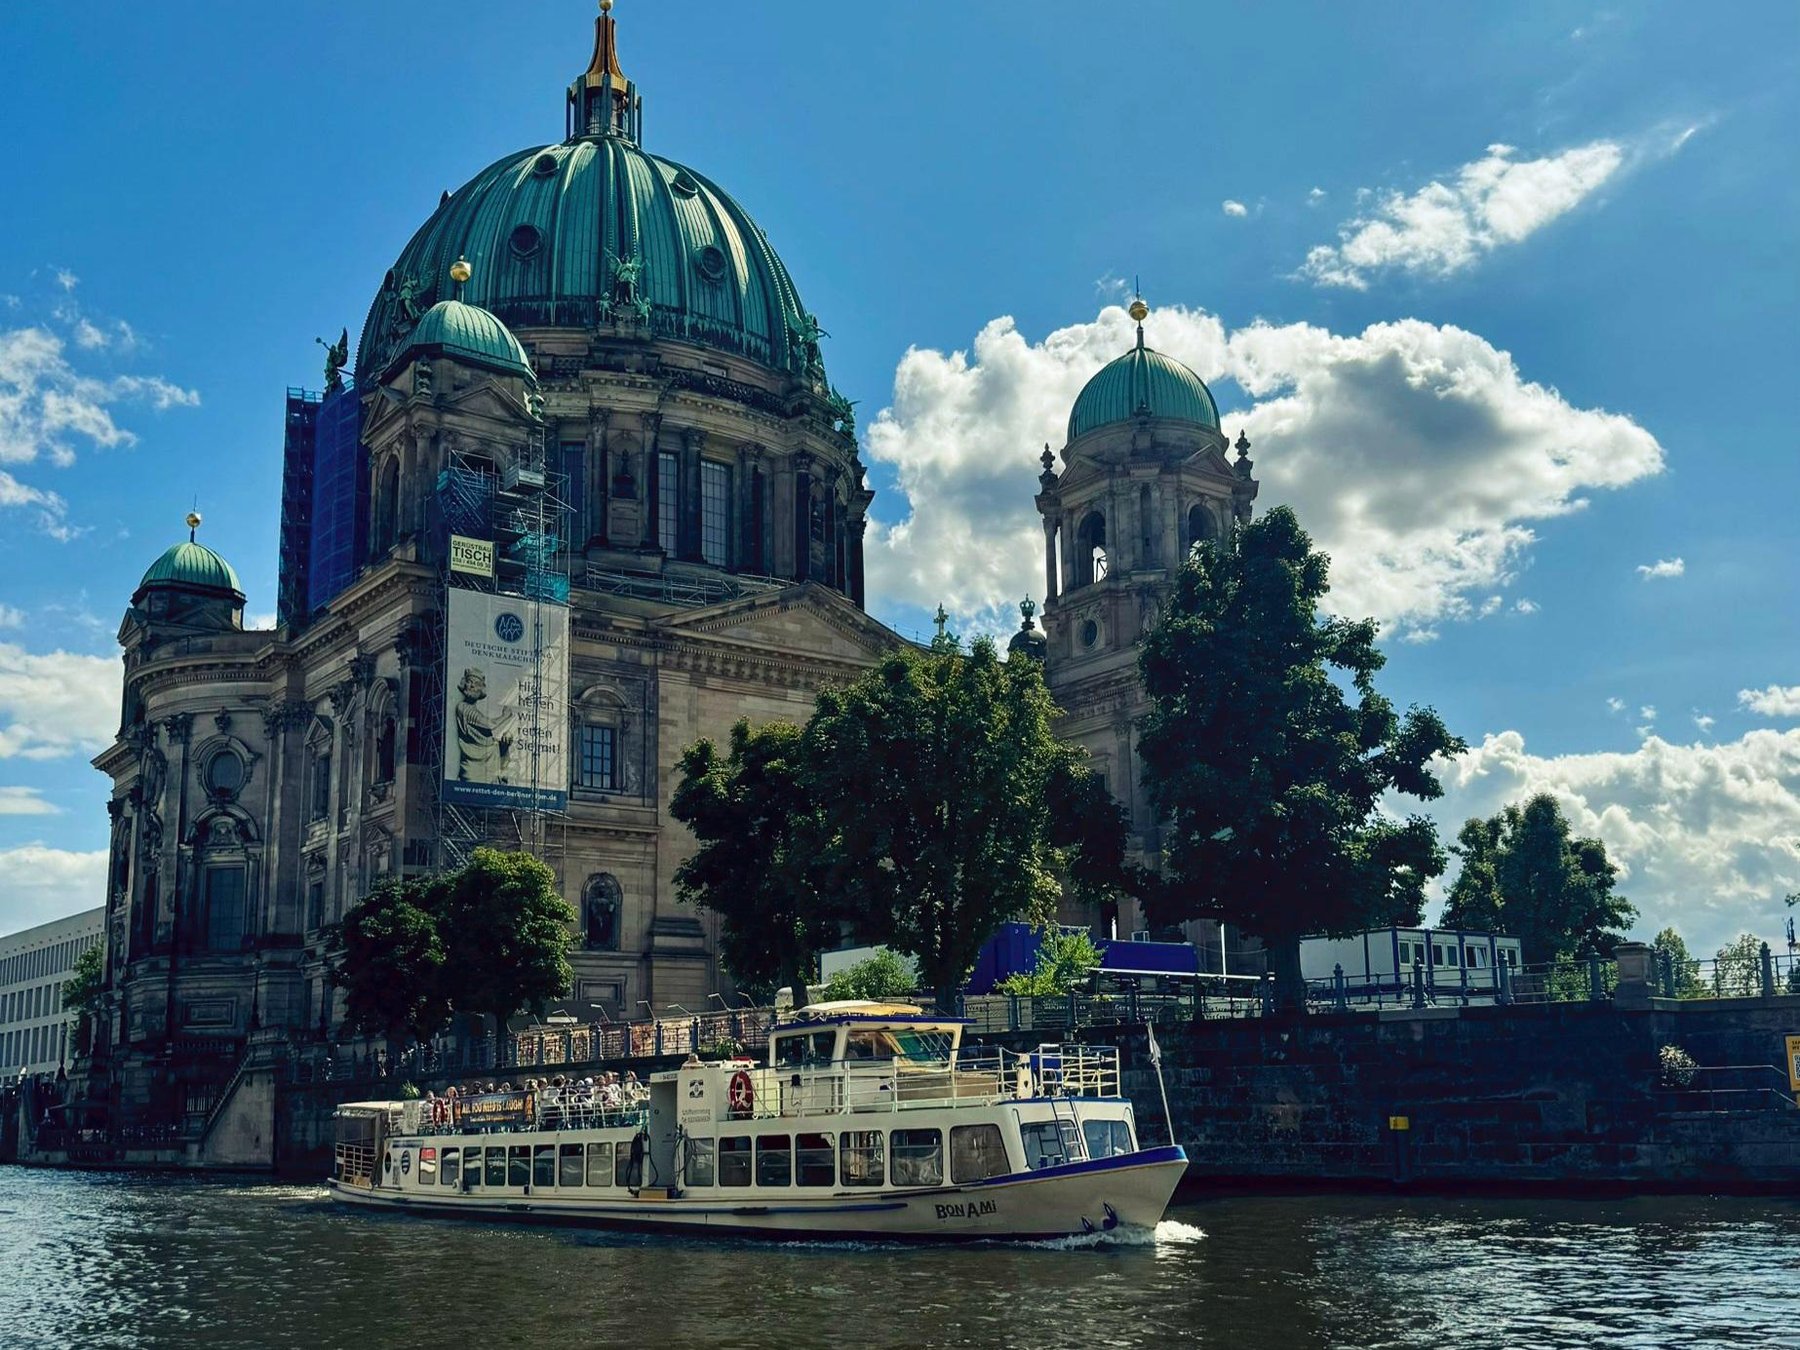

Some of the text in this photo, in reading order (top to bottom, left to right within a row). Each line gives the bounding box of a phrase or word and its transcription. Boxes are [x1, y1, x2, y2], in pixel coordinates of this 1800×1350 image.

[452, 546, 492, 563] TISCH
[464, 640, 552, 659] DEUTSCHE STIFTNG
[518, 694, 554, 711] heen
[516, 739, 560, 754] Sie mit!
[934, 1204, 966, 1219] BON
